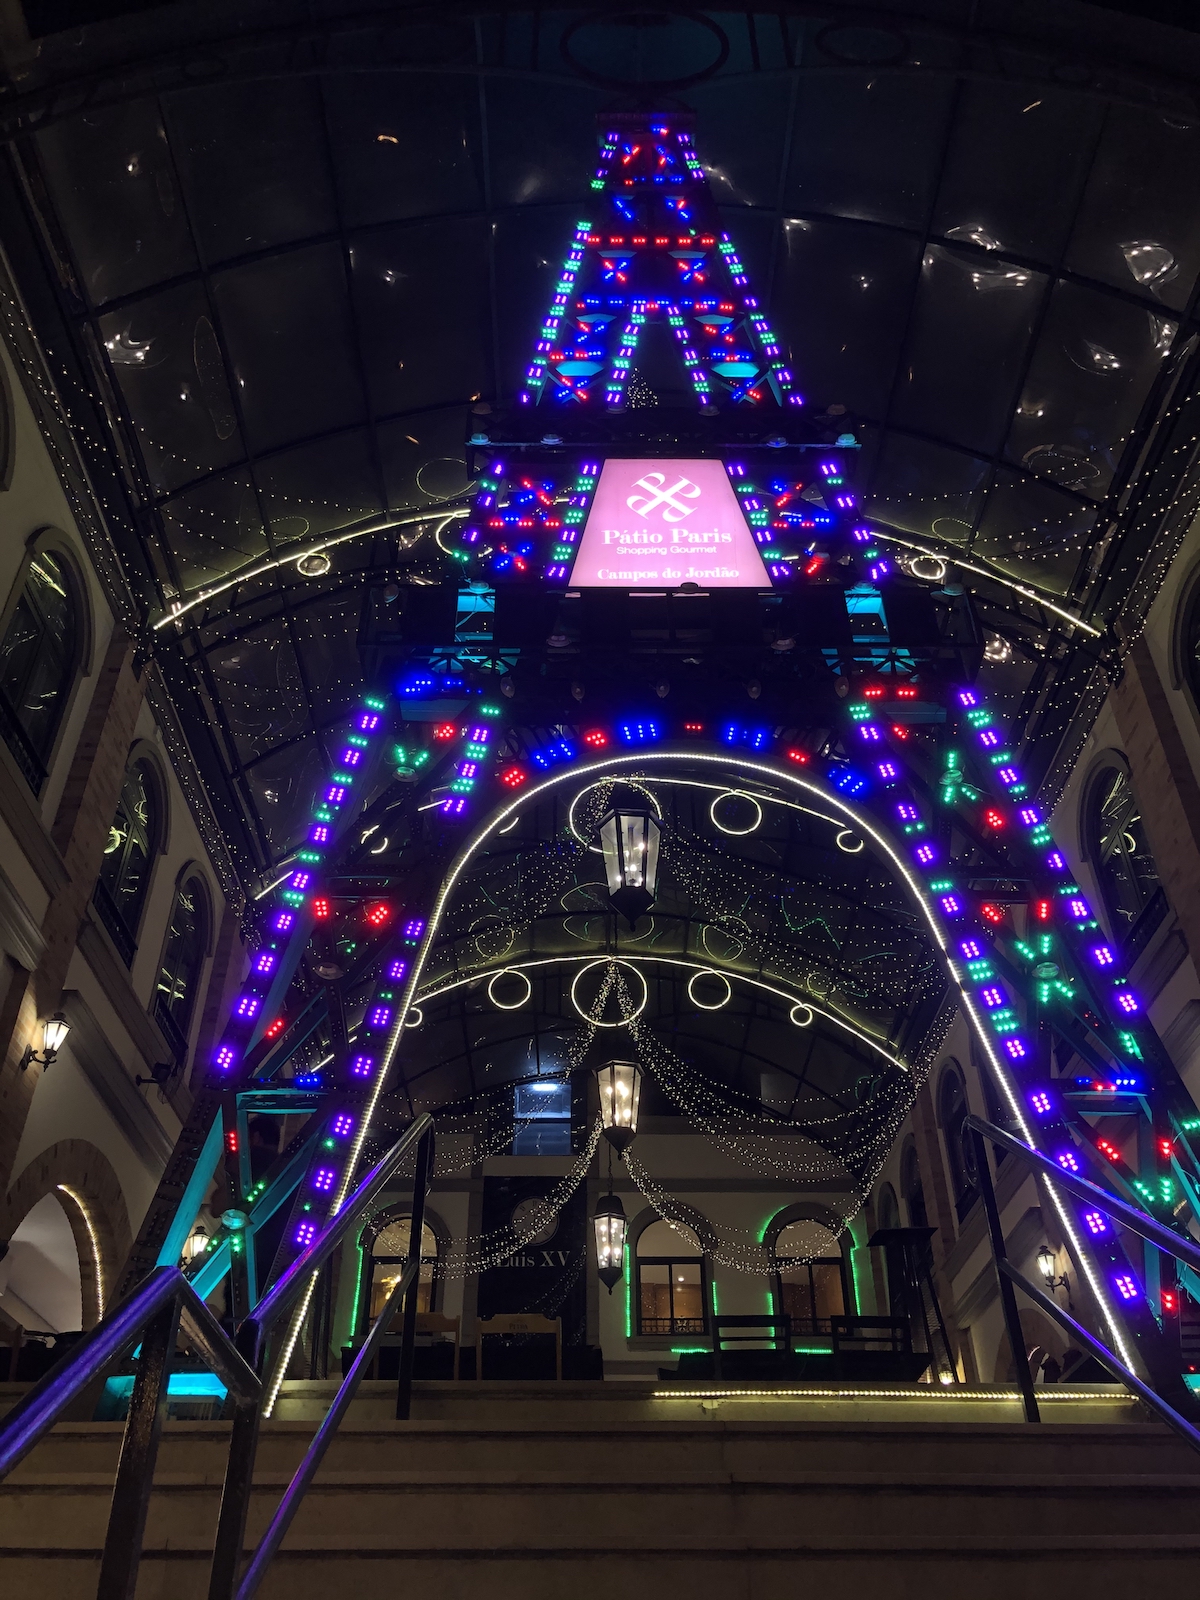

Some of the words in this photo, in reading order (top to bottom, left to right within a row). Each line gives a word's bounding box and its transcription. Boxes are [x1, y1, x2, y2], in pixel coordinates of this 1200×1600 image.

[601, 529, 663, 545] Pátio
[669, 528, 733, 544] Paris
[616, 546, 668, 555] Shopping
[670, 545, 717, 554] Gourmet
[597, 568, 658, 582] Campos
[662, 567, 681, 579] do
[685, 567, 739, 579] Jordão
[540, 1251, 571, 1267] XV
